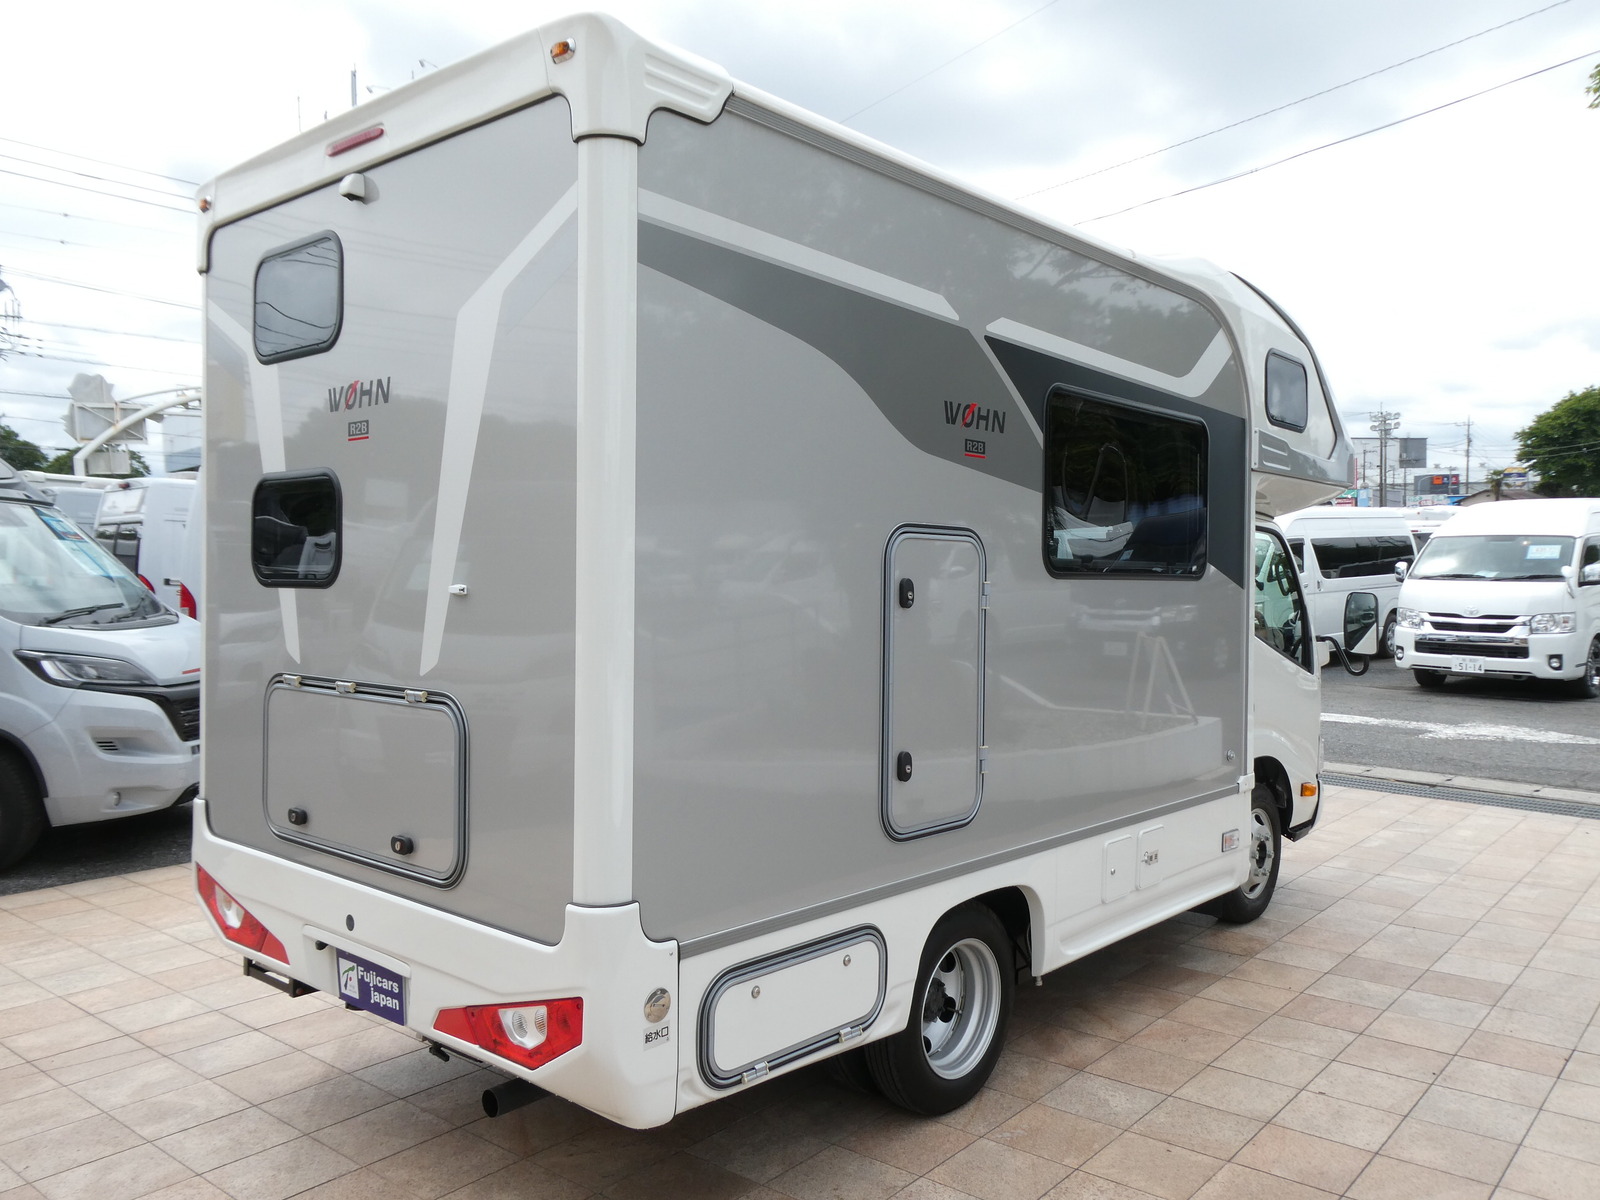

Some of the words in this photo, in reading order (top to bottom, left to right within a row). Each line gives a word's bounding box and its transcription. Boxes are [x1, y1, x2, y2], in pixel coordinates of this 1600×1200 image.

[349, 421, 368, 436] R2B
[966, 440, 984, 453] R2B
[357, 965, 400, 994] Fujicars
[370, 987, 400, 1011] japan
